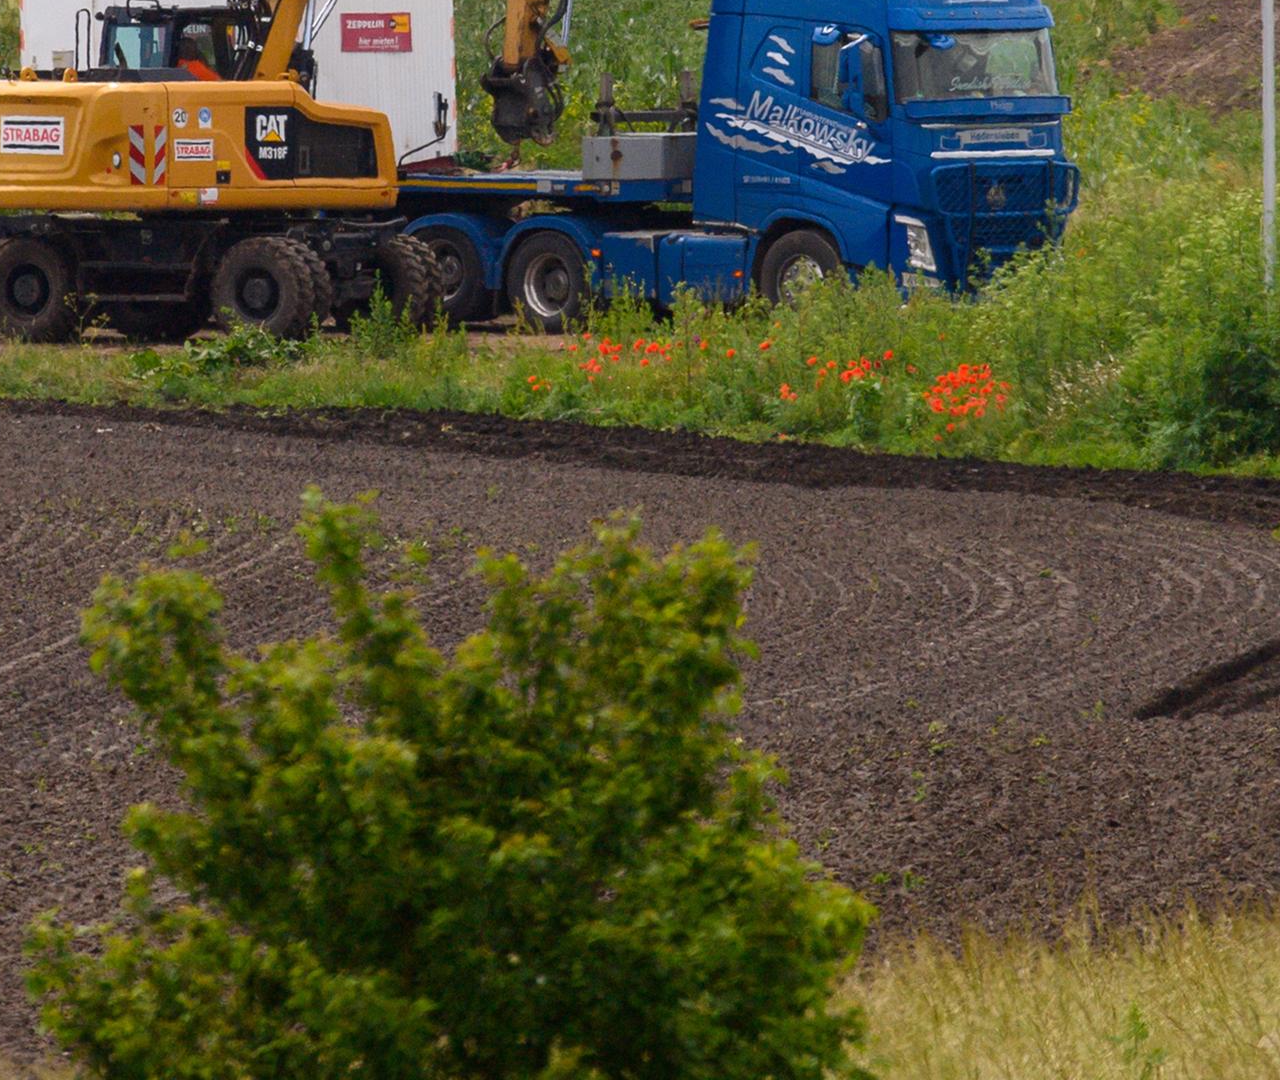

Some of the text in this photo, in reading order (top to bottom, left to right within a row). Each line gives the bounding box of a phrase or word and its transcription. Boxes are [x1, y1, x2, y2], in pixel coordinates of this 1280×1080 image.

[346, 20, 384, 29] ZEPPELIN
[174, 111, 187, 123] 20
[256, 114, 288, 142] CAT
[745, 89, 876, 162] Malkowsky
[2, 127, 60, 142] STRABAG
[176, 146, 211, 156] STRABAG
[258, 146, 288, 160] M318F
